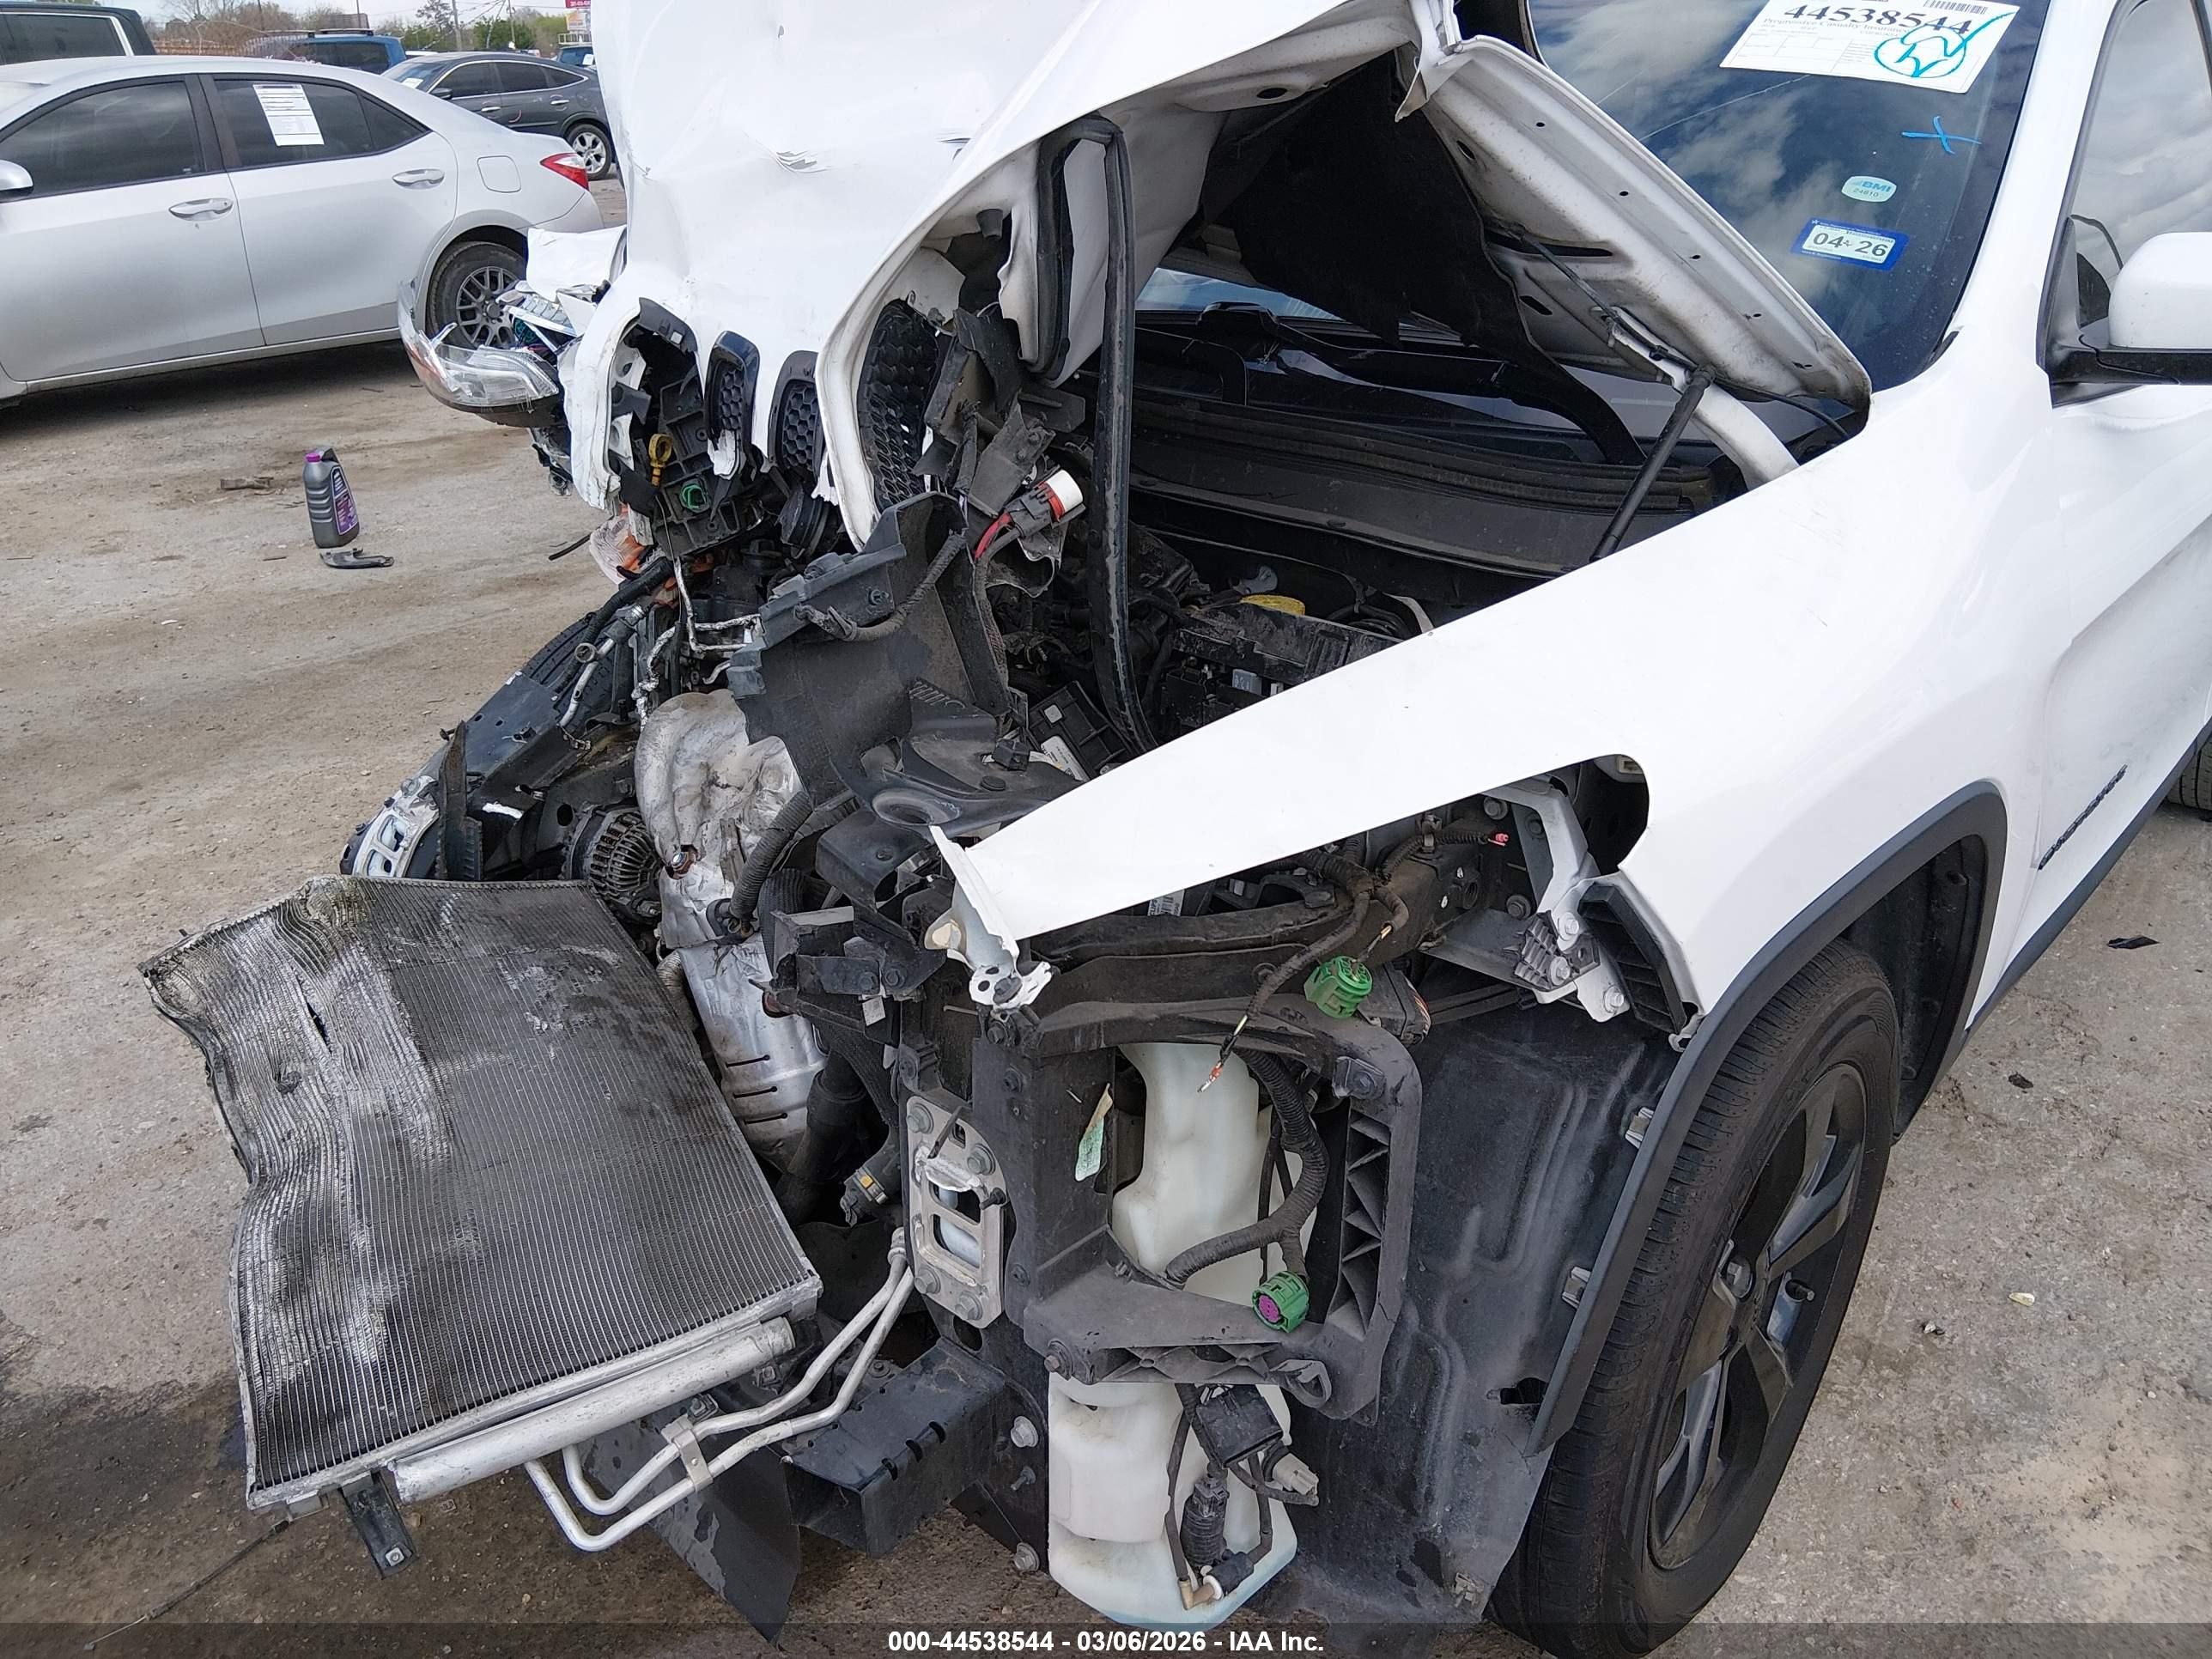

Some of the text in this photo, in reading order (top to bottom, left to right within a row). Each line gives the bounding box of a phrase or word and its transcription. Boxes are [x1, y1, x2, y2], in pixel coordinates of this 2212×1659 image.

[1784, 4, 1972, 34] 44538544
[1862, 180, 1892, 192] BMI
[1813, 232, 1844, 248] 04
[1854, 240, 1889, 257] 26
